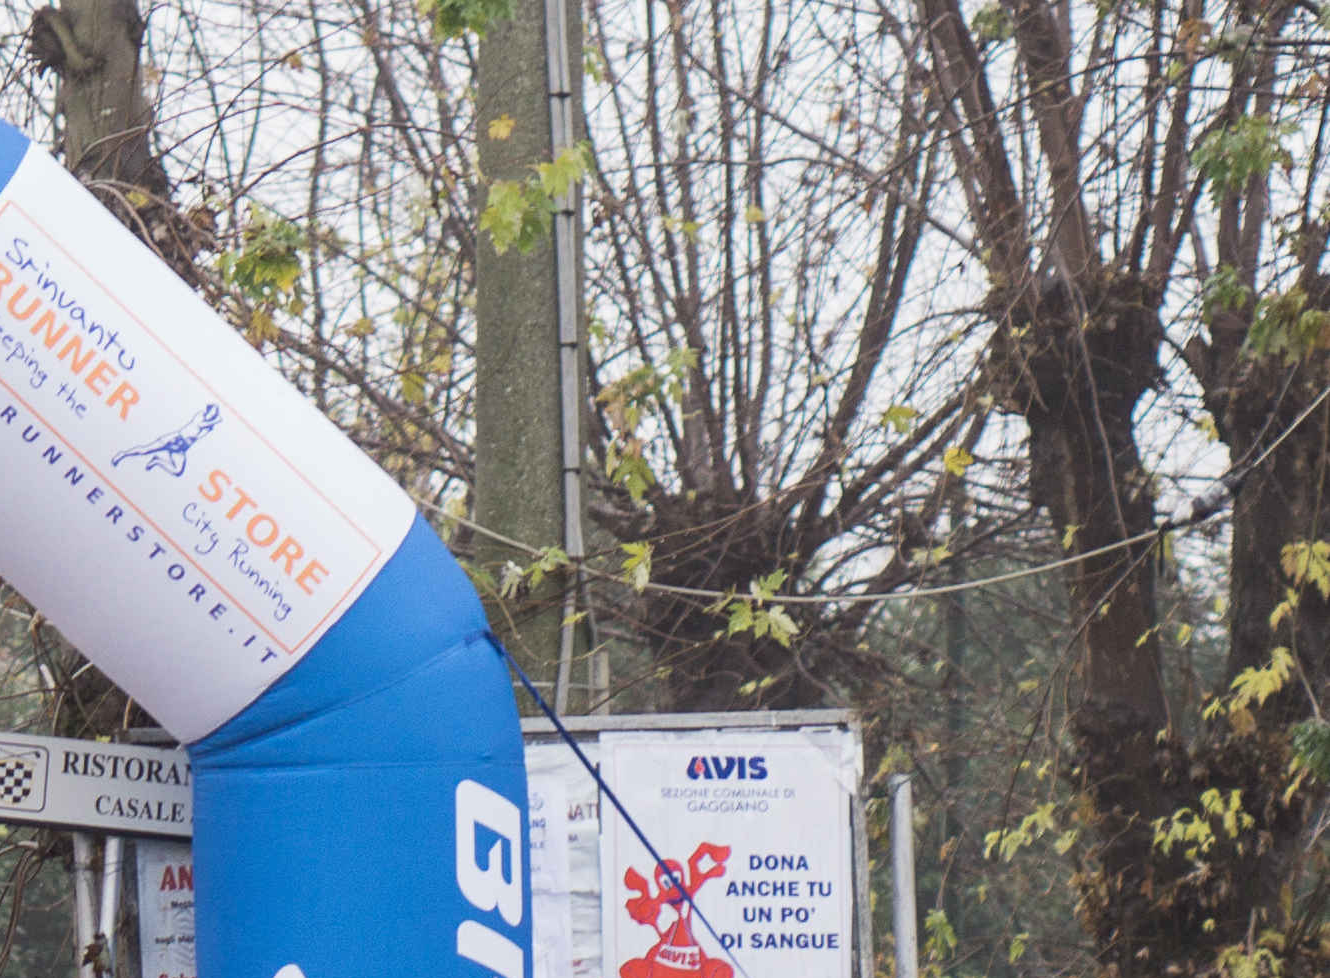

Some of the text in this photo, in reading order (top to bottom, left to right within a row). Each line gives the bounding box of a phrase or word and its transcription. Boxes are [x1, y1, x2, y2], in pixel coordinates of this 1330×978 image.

[57, 379, 89, 419] the
[197, 469, 330, 596] STORE
[181, 502, 292, 624] City Running
[687, 756, 768, 780] AVIS
[660, 788, 796, 799] SEZIONE COMUNALE DI
[96, 794, 185, 824] CASALE
[687, 800, 769, 813] GAGGIANO
[749, 855, 809, 871] DONA
[726, 881, 832, 897] ANCHE TU
[743, 906, 816, 923] UN PO'
[721, 933, 840, 950] DI SANGUE
